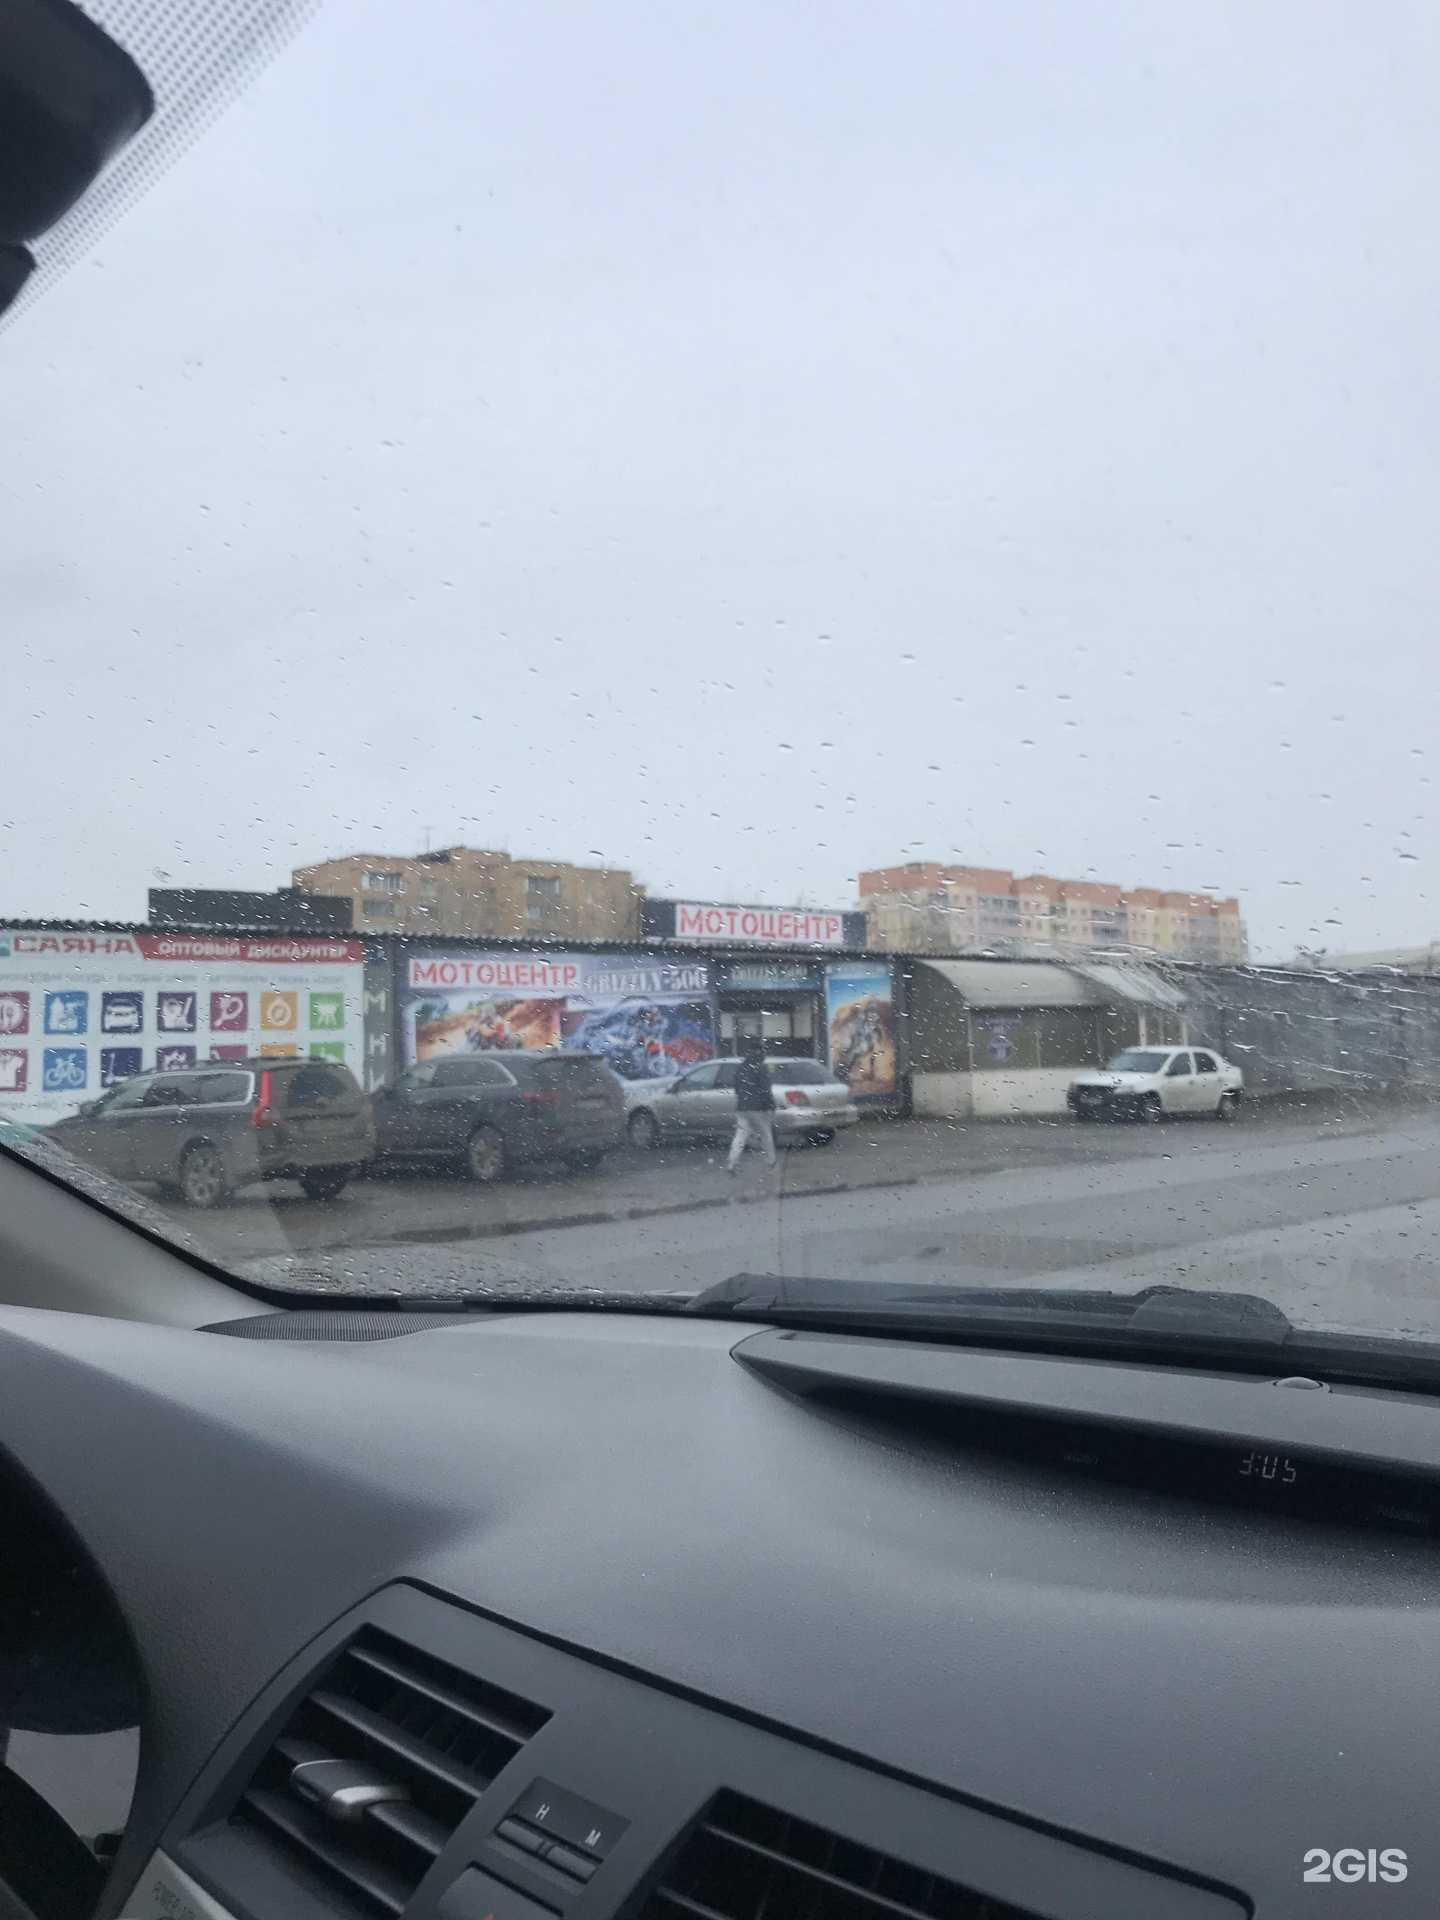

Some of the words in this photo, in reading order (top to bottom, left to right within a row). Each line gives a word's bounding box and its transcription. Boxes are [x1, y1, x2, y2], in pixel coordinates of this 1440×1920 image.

[680, 908, 839, 939] МОТОЦЕНТР
[14, 936, 134, 953] САЯНА
[160, 942, 240, 956] ОПТОВЫЙ
[247, 944, 347, 958] ДИСКАУНТЕР
[413, 961, 577, 986] МОТОЦЕНТР
[1239, 1452, 1297, 1482] 3:05
[535, 1803, 550, 1820] H
[585, 1829, 601, 1848] M
